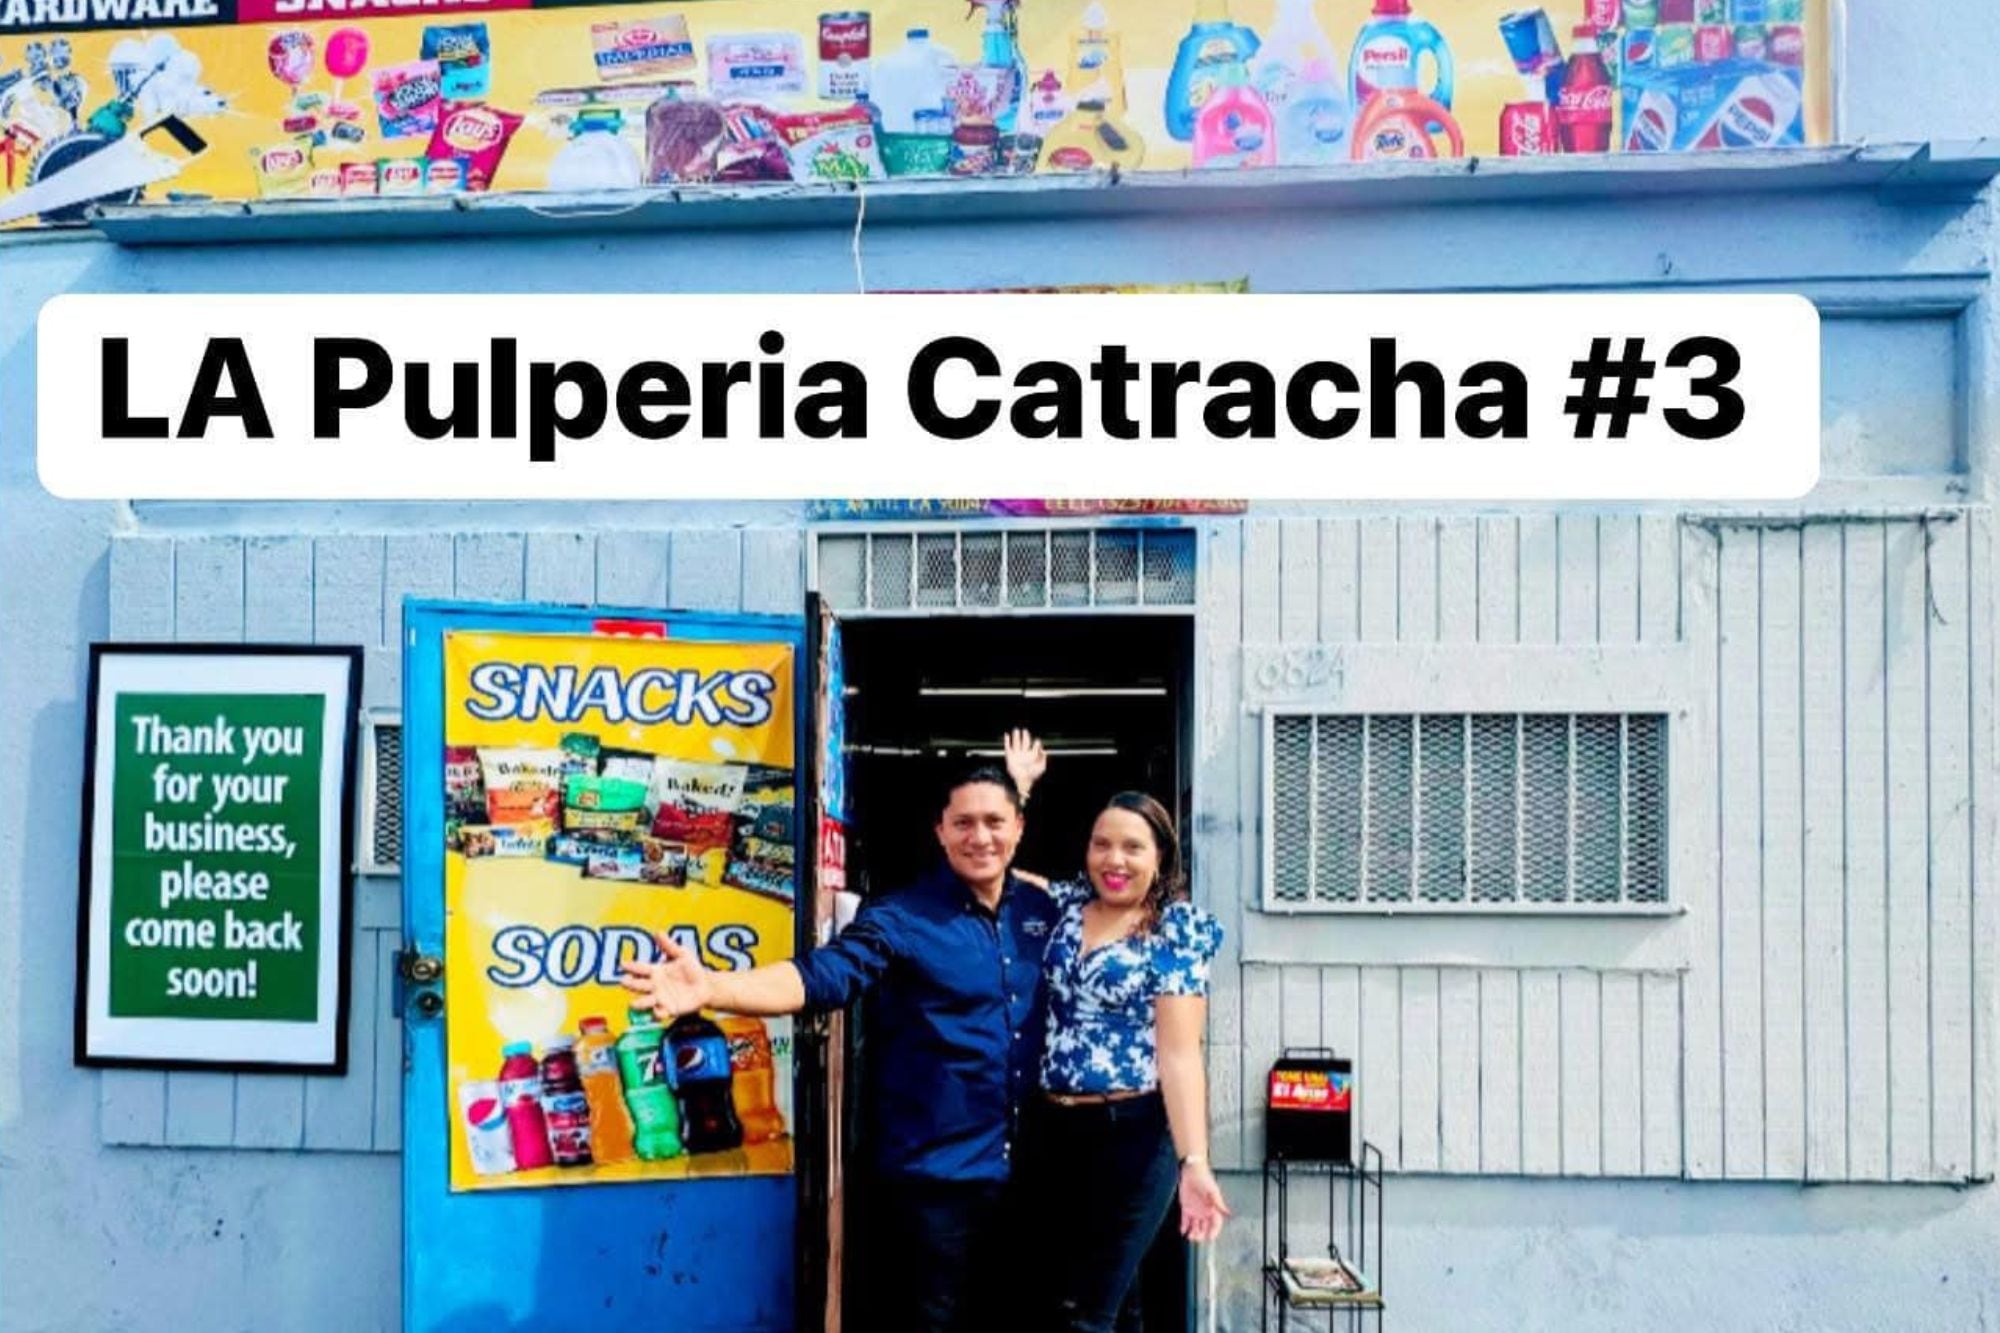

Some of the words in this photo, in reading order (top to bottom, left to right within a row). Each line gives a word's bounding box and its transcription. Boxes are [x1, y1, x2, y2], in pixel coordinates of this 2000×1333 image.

[1363, 47, 1408, 62] Persil
[467, 662, 776, 727] SNACKS
[131, 715, 234, 756] Thank
[243, 727, 303, 765] you
[152, 763, 201, 802] for
[211, 773, 289, 812] your
[145, 812, 296, 858] business,
[160, 861, 269, 909] please
[125, 918, 216, 950] come
[224, 910, 303, 951] back
[166, 960, 257, 998] soon!
